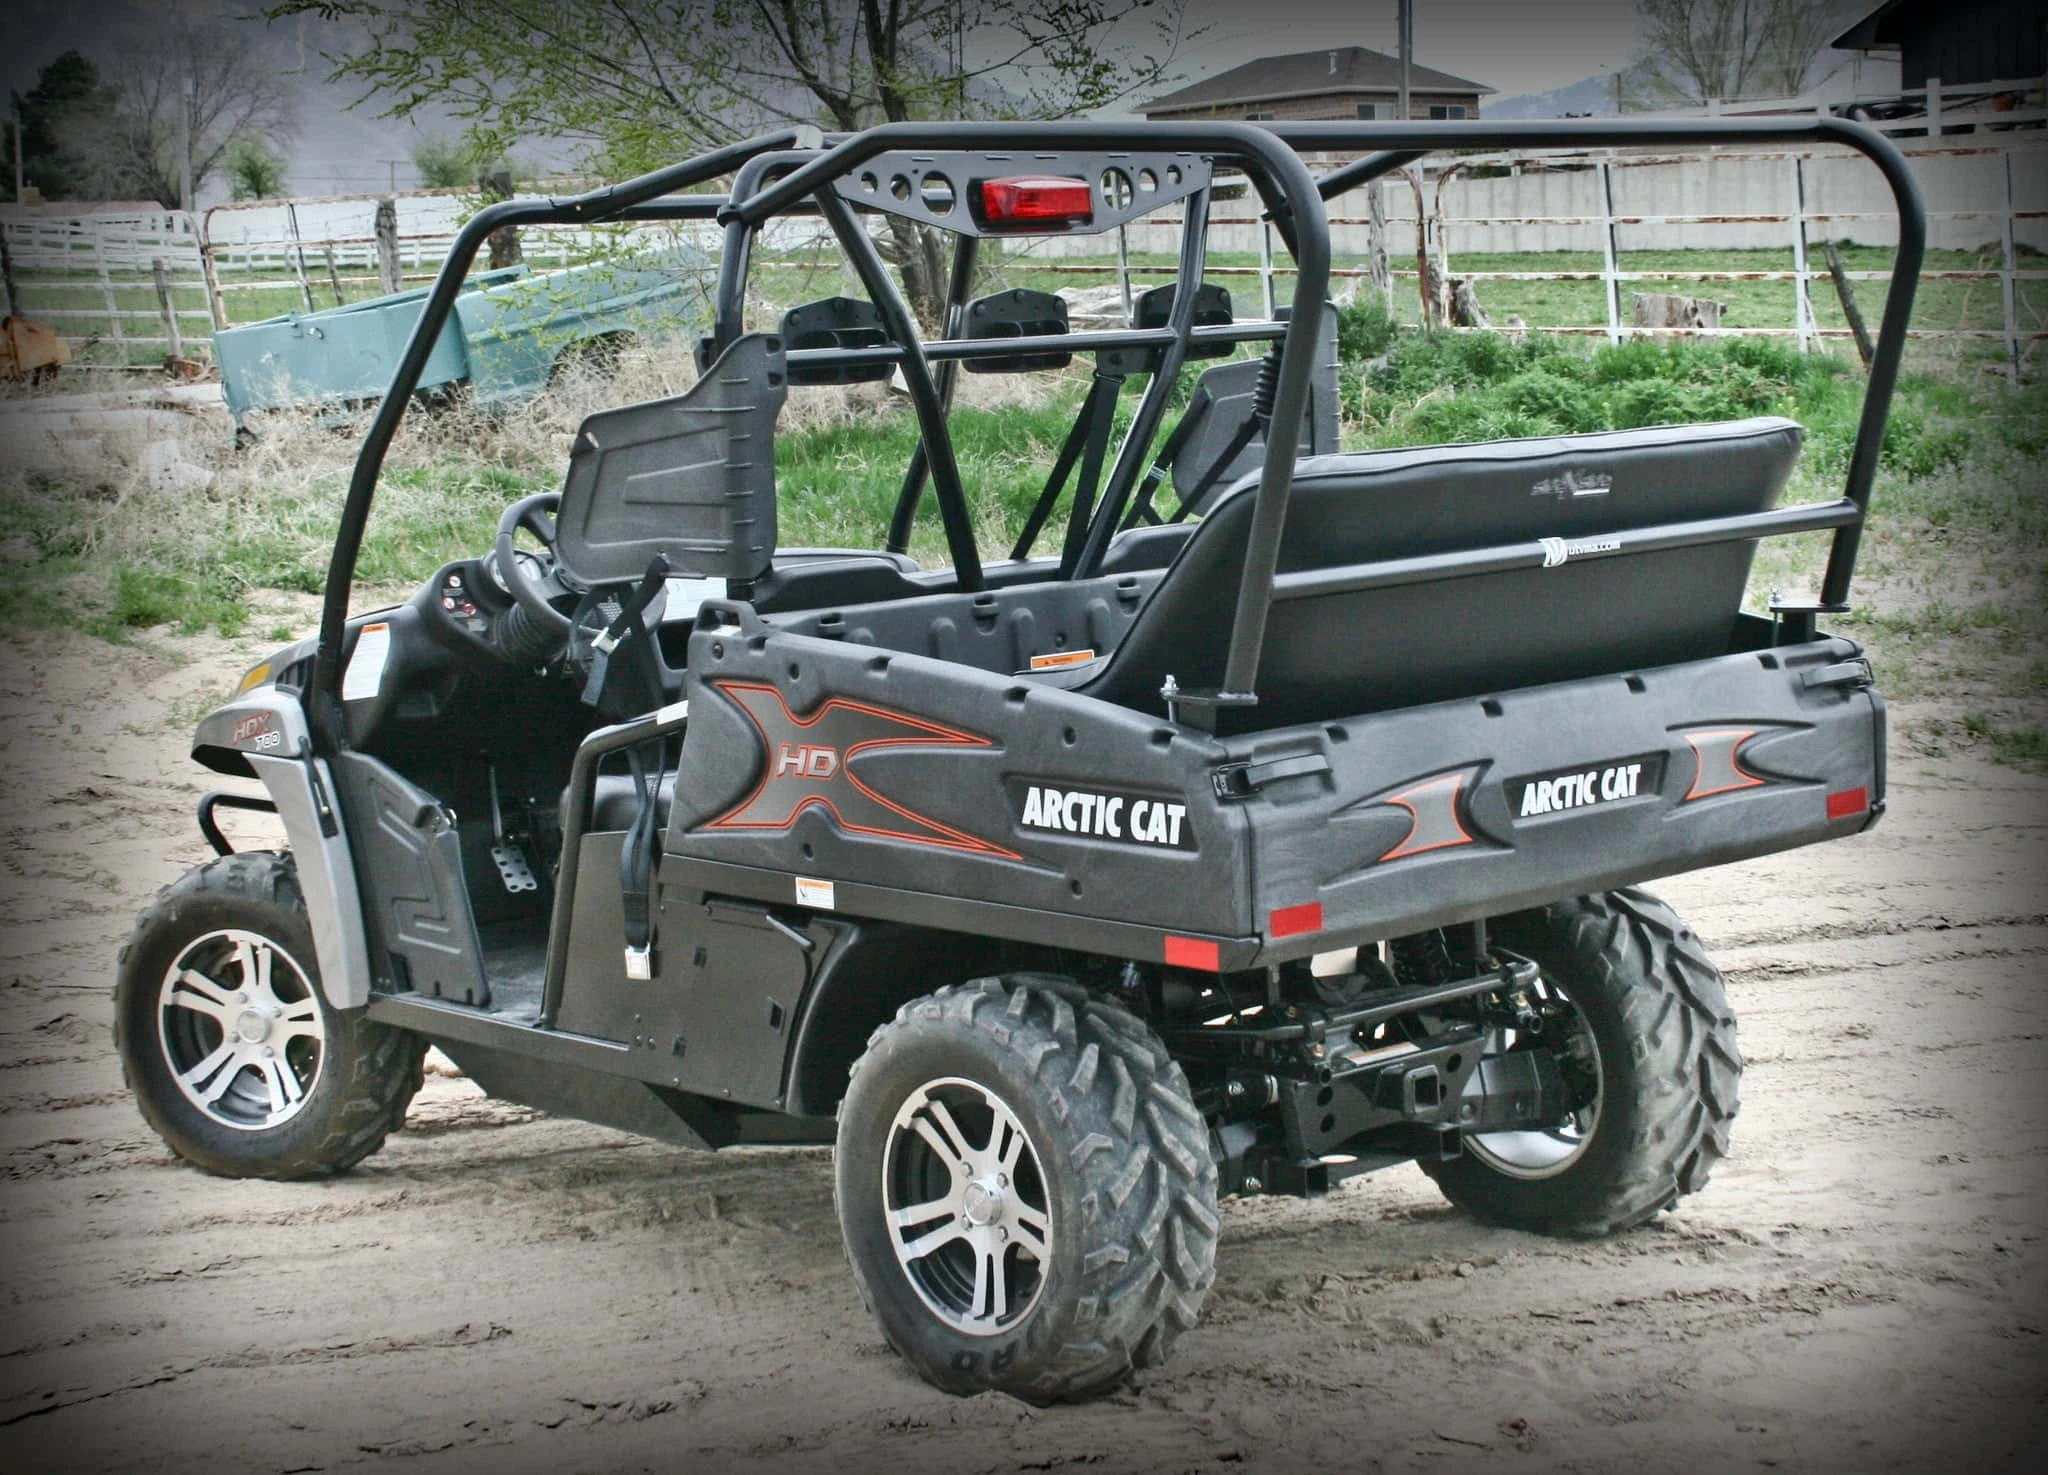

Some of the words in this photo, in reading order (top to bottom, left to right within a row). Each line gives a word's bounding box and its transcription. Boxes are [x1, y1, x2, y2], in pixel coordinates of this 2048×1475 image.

[232, 710, 273, 746] HDX
[255, 730, 280, 751] 700
[776, 743, 840, 781] HD
[1520, 771, 1597, 817] ARCTIC
[1601, 763, 1641, 801] CAT
[1021, 786, 1124, 838] ARCTIC
[1130, 800, 1186, 845] CAT
